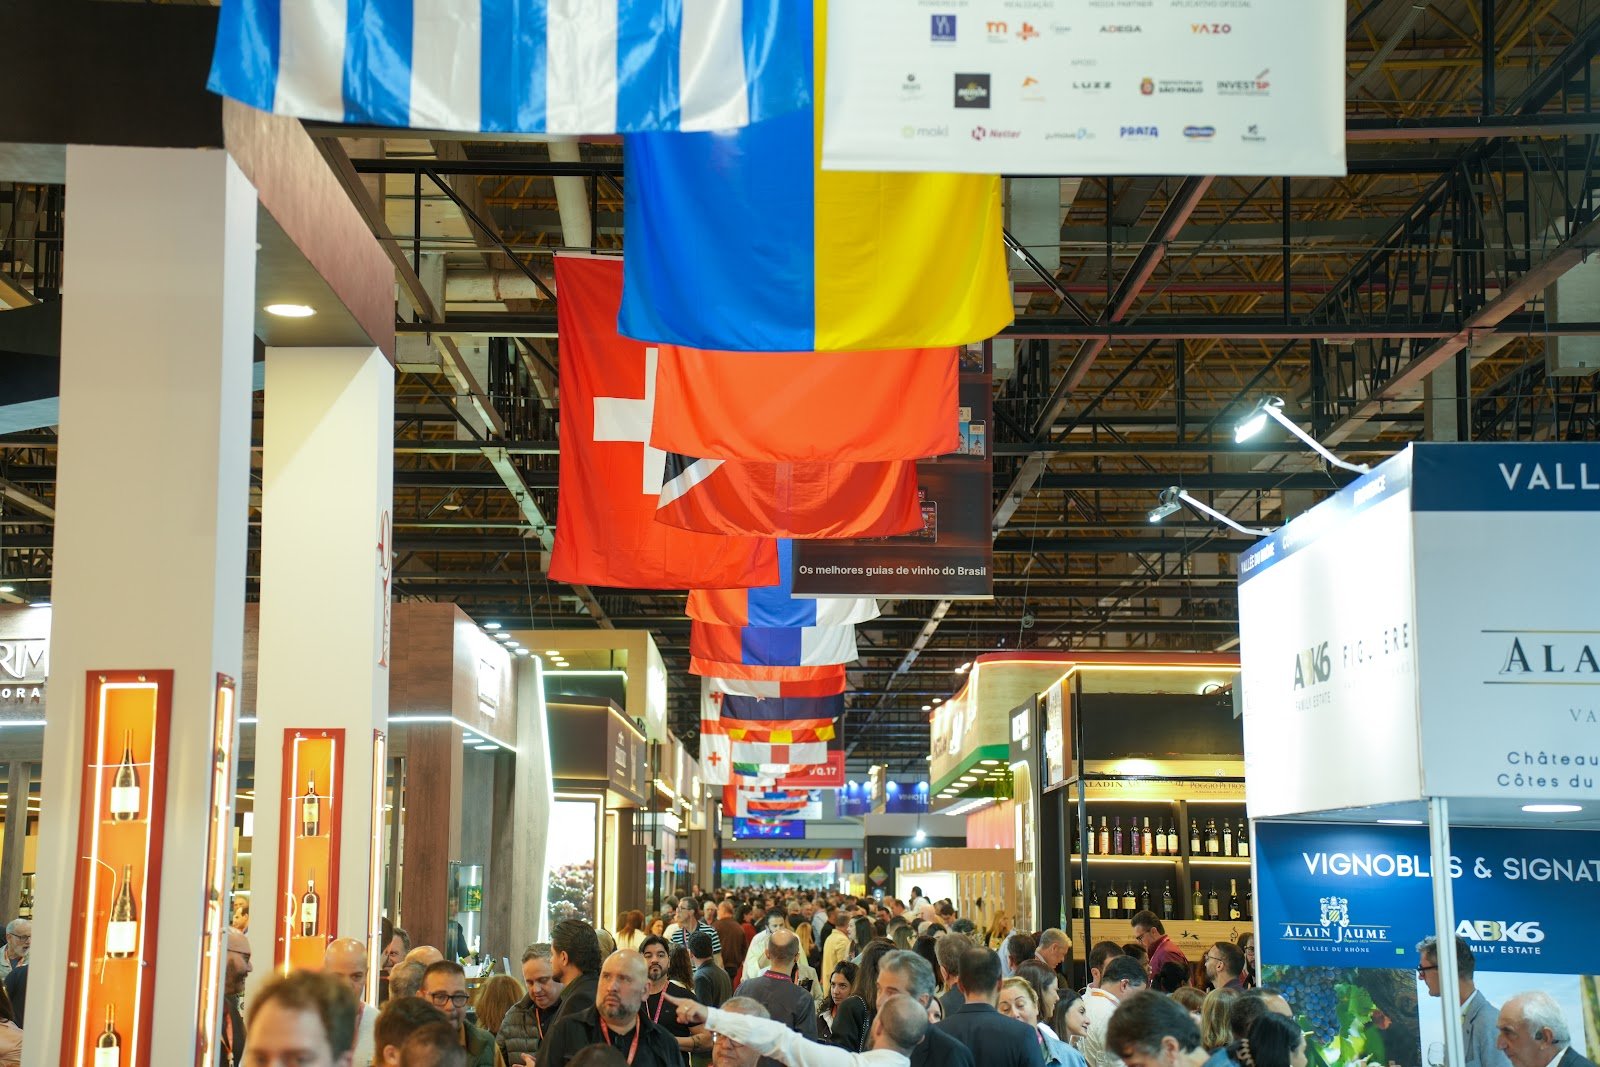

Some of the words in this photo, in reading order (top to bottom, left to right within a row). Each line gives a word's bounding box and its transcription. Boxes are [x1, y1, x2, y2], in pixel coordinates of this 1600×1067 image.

[1191, 23, 1232, 34] YAZO
[1498, 462, 1600, 491] VALL
[799, 565, 814, 575] Os
[815, 565, 864, 575] melhores
[865, 566, 894, 577] guias
[895, 566, 910, 576] de
[911, 565, 940, 576] vinho
[942, 566, 956, 576] do
[957, 566, 986, 577] Brasil
[1499, 636, 1600, 674] ALA
[1507, 751, 1599, 766] Château
[1497, 772, 1559, 788] Côtes
[1569, 774, 1593, 788] du
[1303, 852, 1463, 879] VIGNOBLS
[1473, 856, 1492, 879] &
[1283, 924, 1331, 938] ALAIN
[1334, 926, 1387, 944] JAUME
[1455, 919, 1545, 943] ABK6
[1501, 946, 1541, 955] ESTATE
